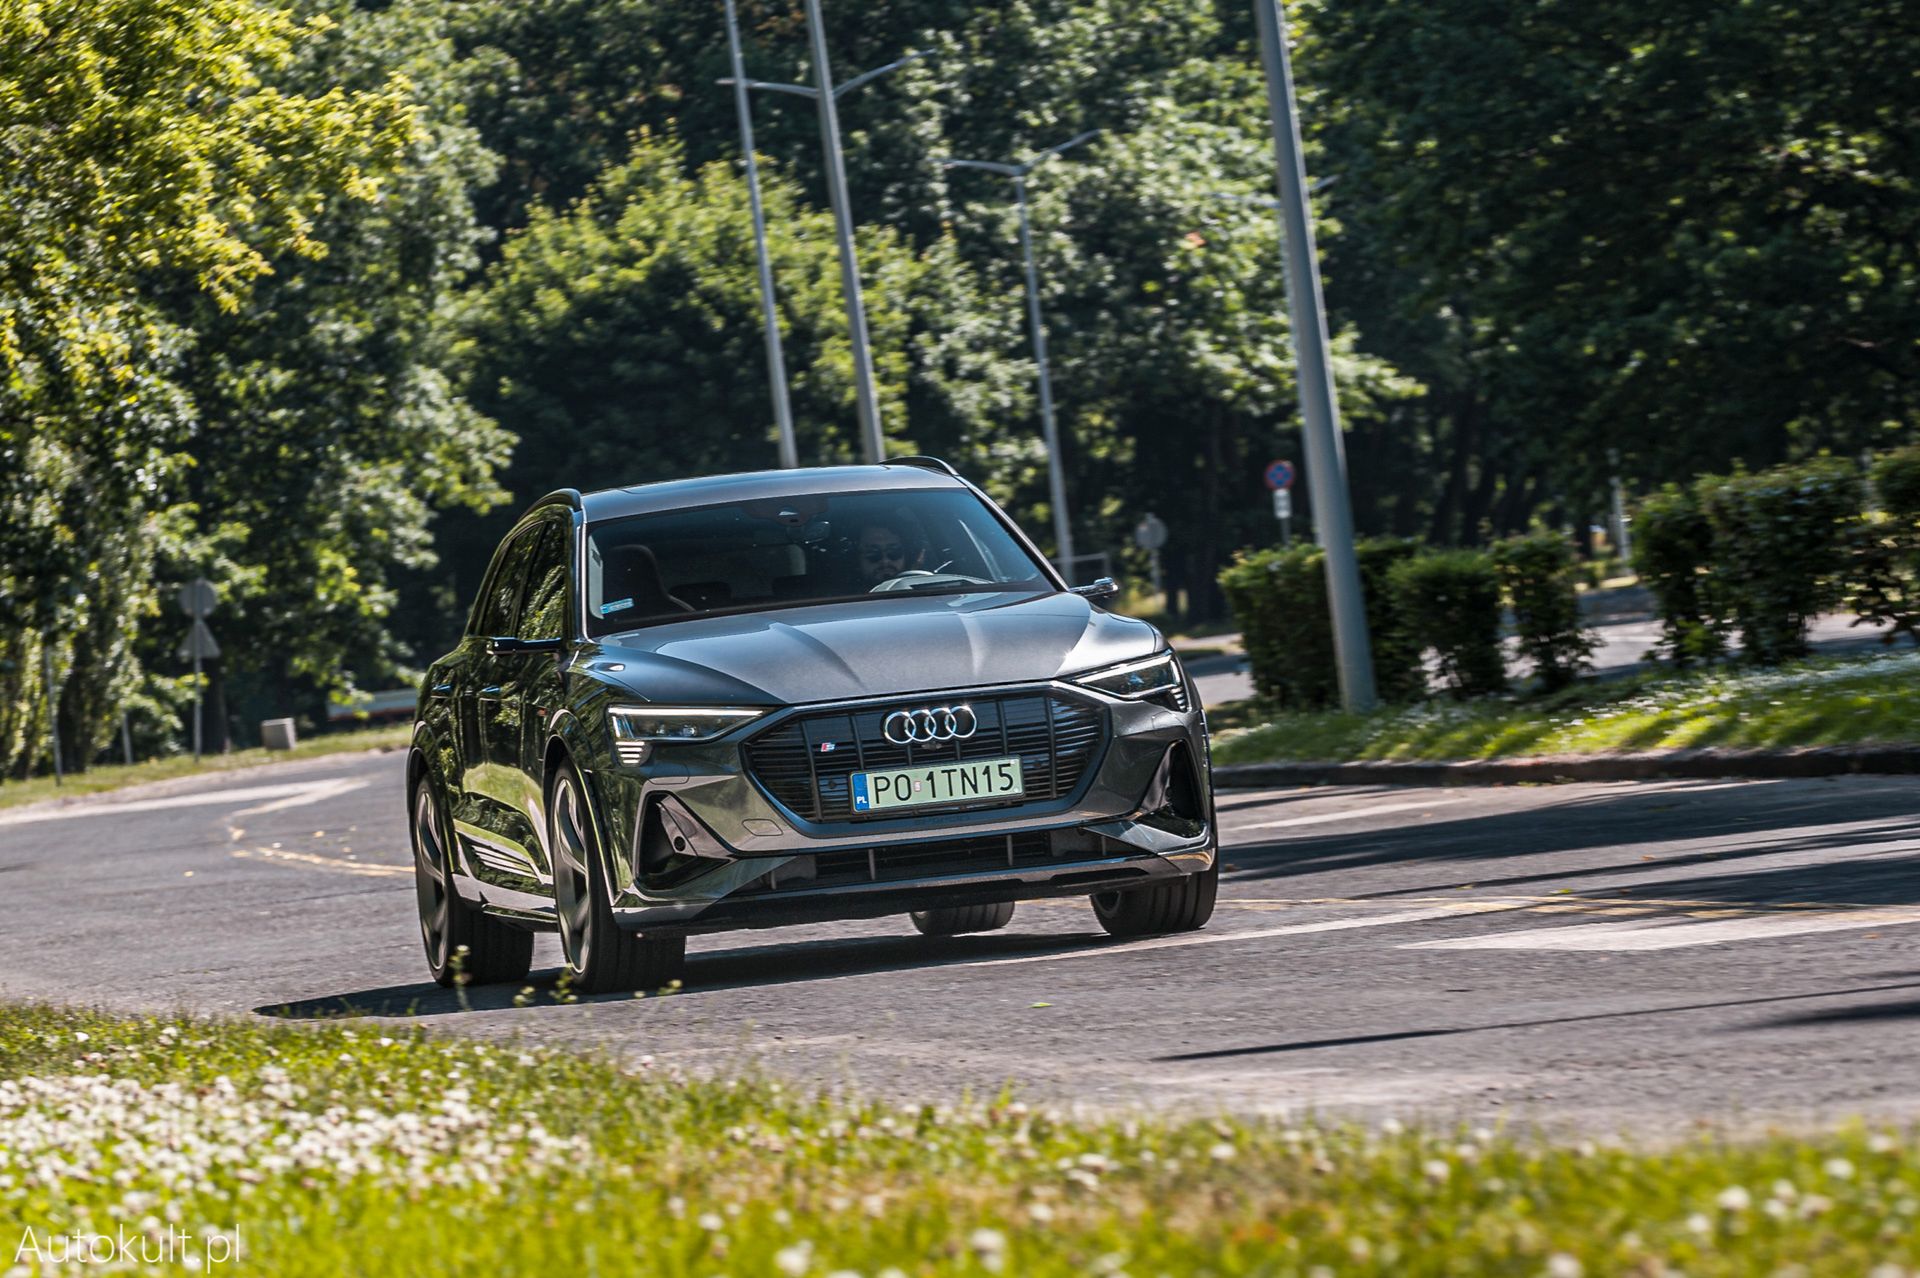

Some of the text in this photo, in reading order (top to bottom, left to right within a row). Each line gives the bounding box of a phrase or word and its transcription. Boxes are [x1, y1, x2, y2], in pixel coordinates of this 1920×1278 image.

[873, 763, 1014, 804] PO 1TN15
[856, 796, 868, 804] PL
